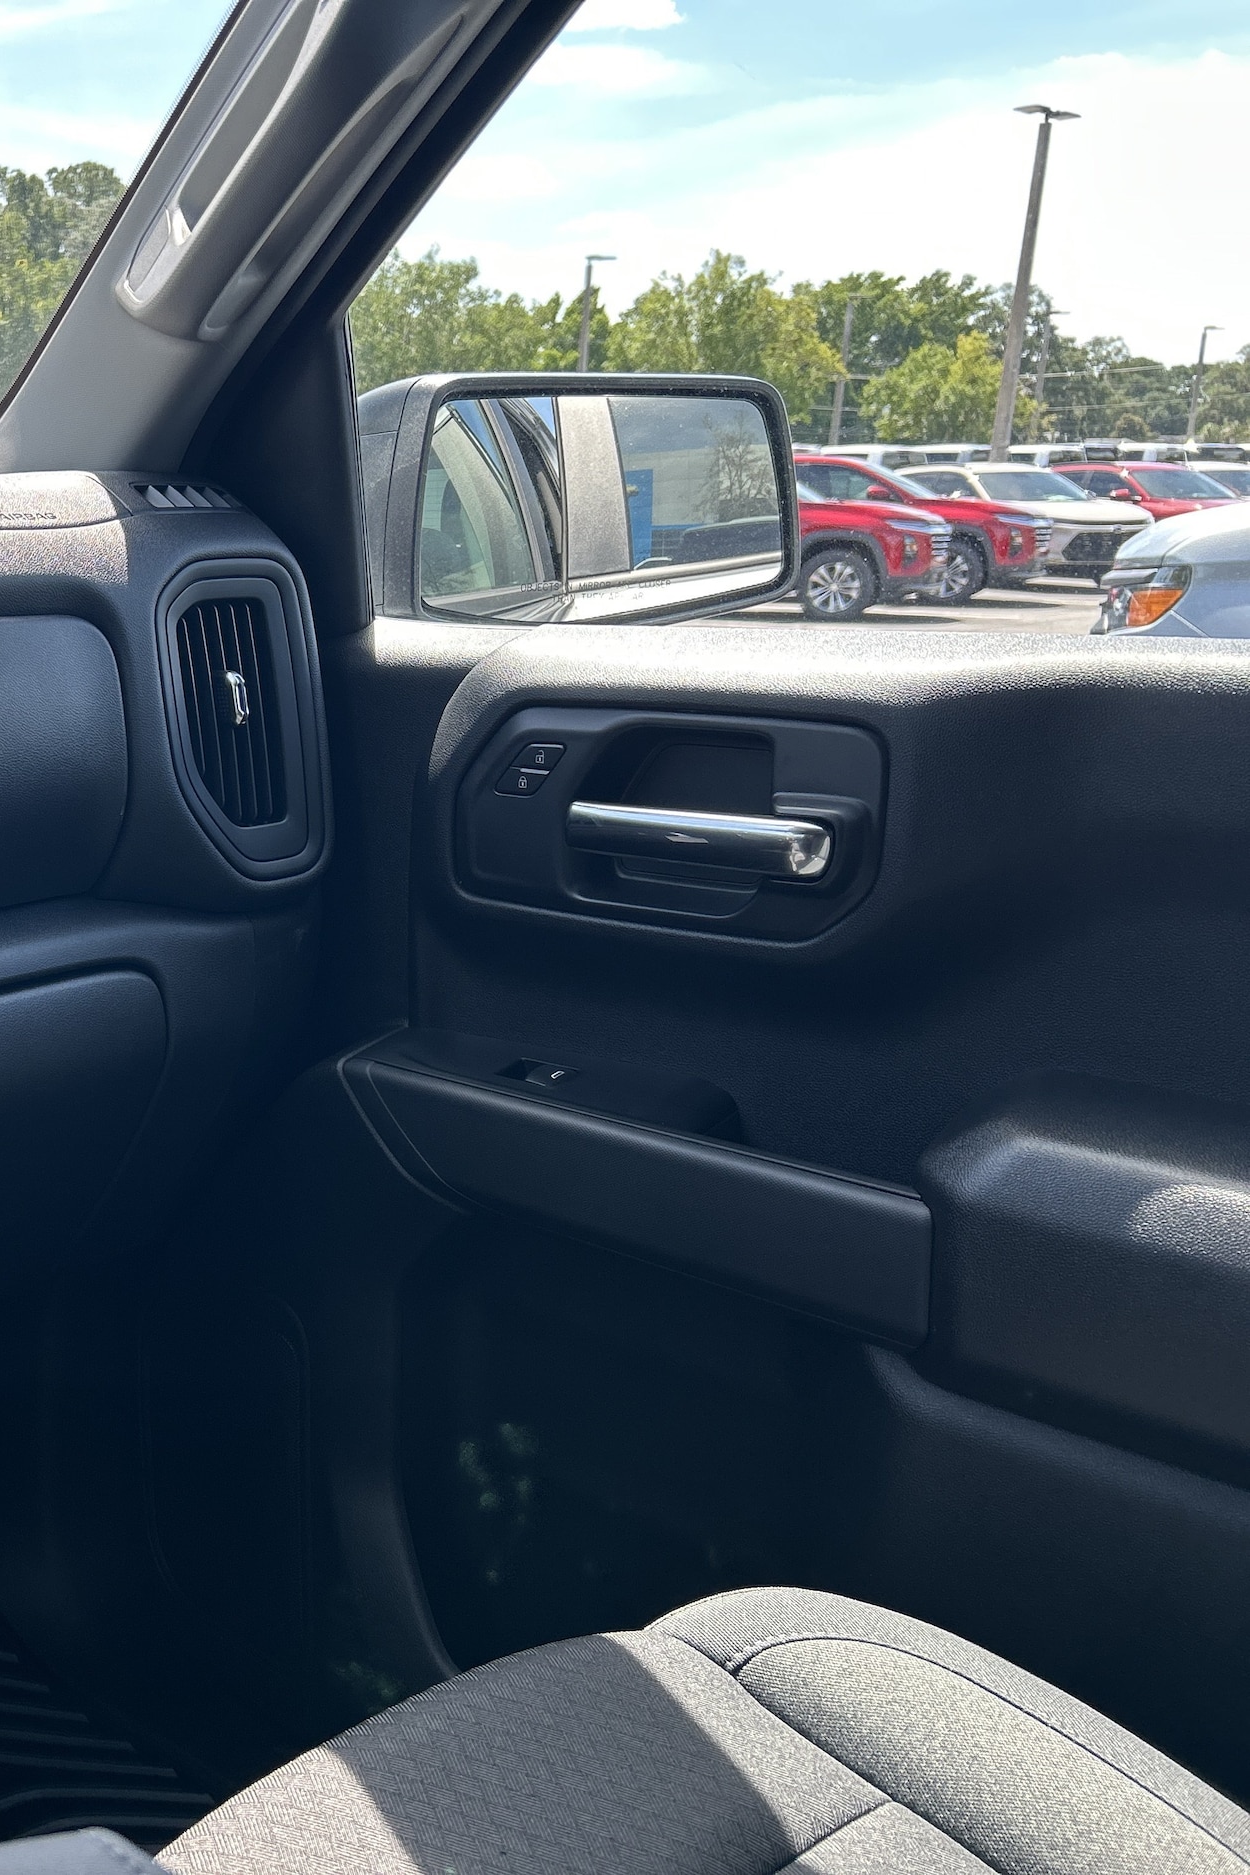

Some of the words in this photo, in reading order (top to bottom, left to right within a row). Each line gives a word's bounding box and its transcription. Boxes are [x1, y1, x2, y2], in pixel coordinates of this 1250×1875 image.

[0, 511, 57, 521] AIRBAG
[520, 582, 559, 592] OBJECTS
[578, 581, 612, 590] MIRROR
[638, 579, 672, 589] CLOSER
